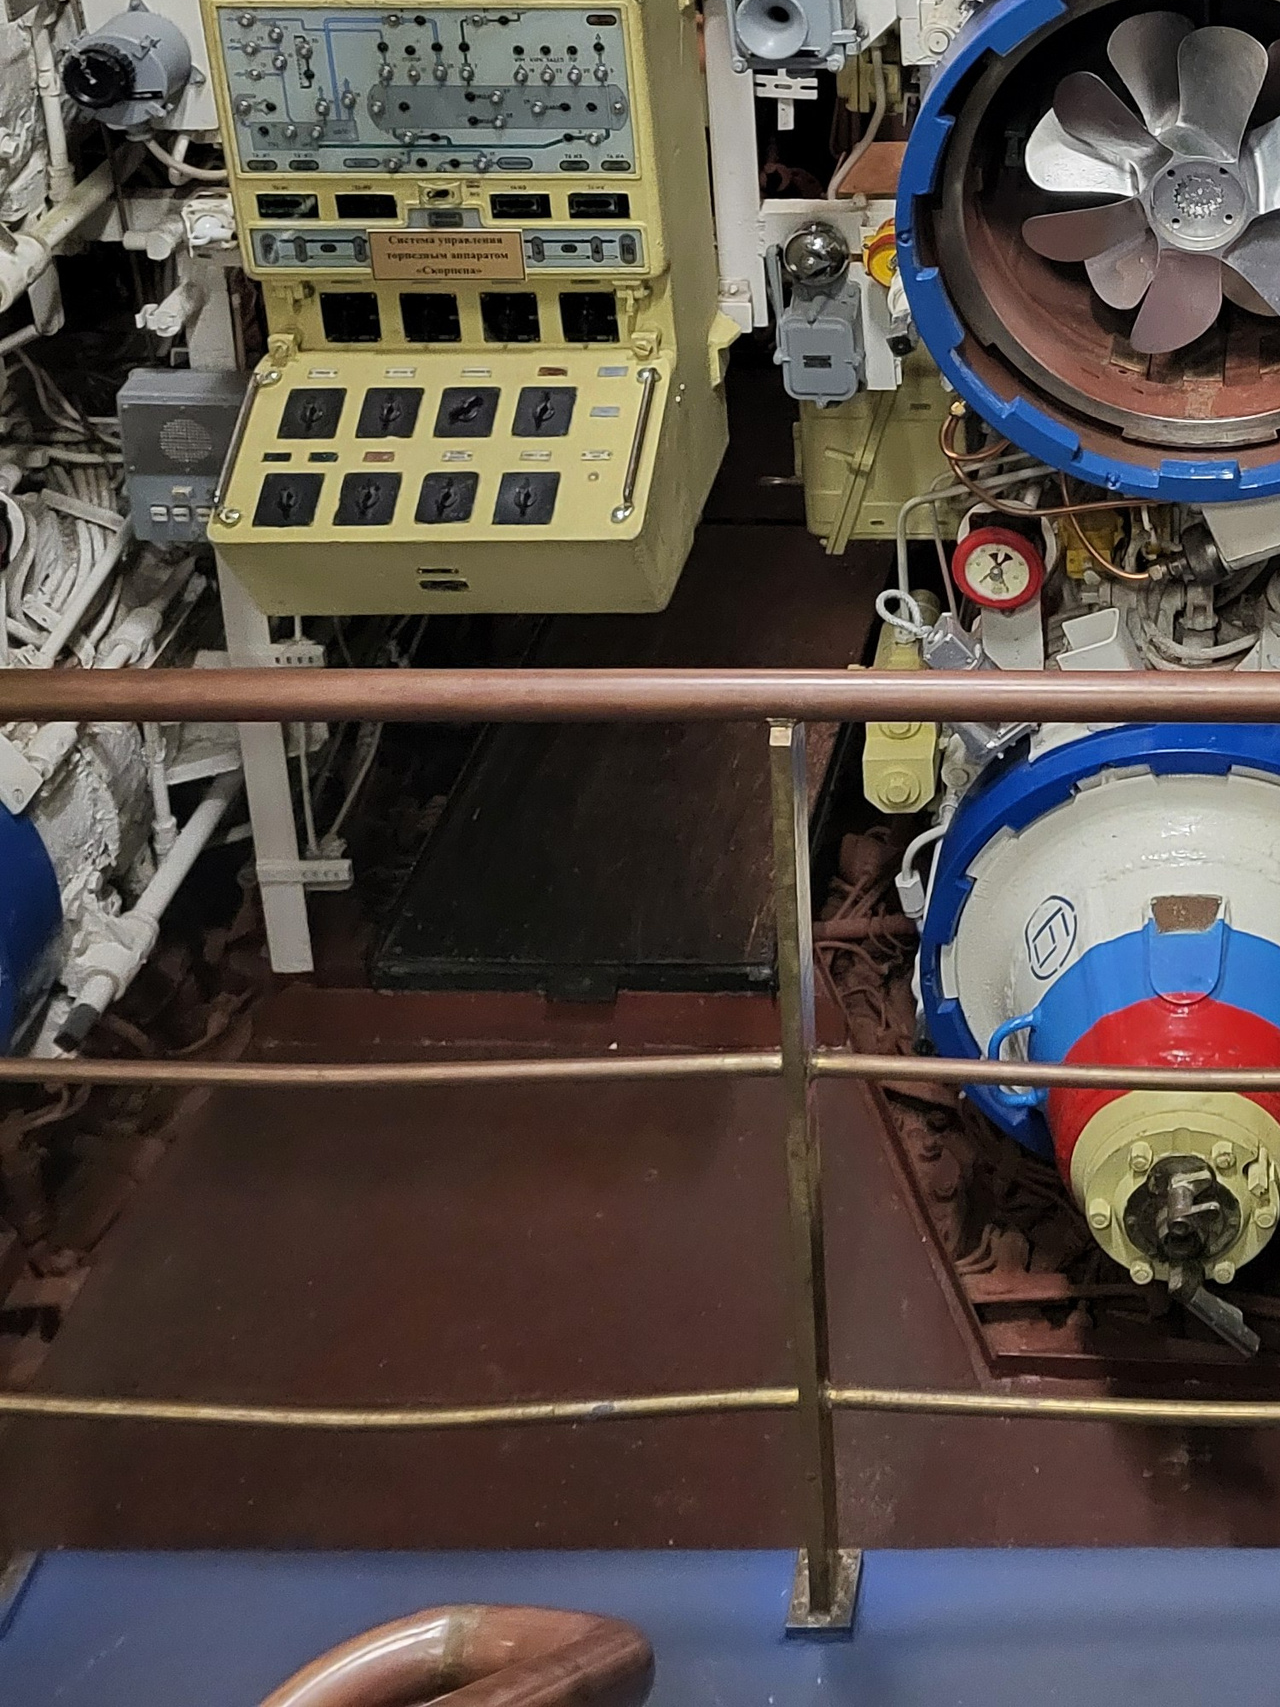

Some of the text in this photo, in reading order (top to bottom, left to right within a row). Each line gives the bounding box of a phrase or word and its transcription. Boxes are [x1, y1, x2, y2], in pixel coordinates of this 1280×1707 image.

[388, 236, 503, 246] Система управления
[387, 252, 508, 261] торпедным аппаратом
